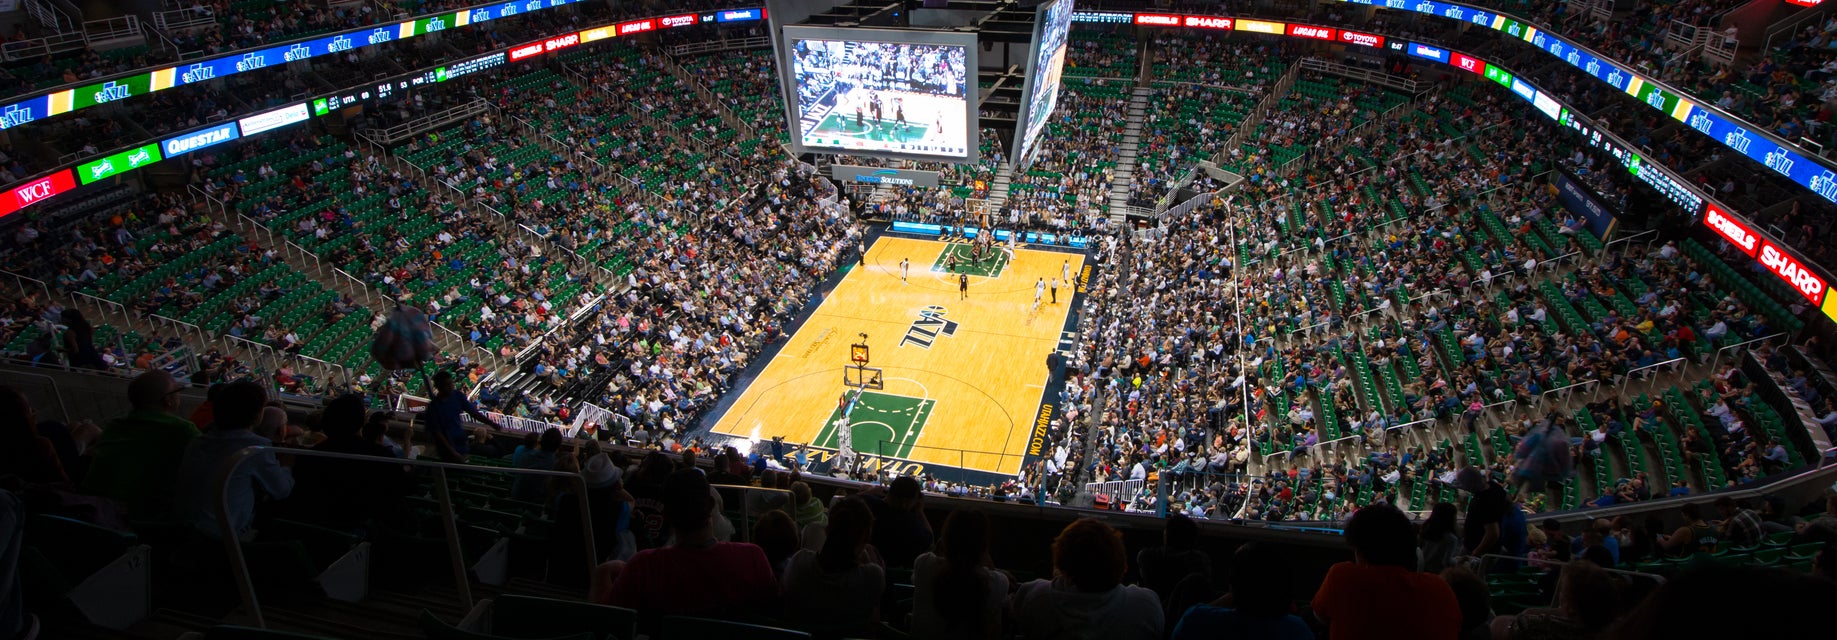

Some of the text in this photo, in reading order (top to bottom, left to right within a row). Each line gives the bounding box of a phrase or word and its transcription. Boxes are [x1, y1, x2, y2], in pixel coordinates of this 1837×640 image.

[1186, 16, 1230, 28] SHARP
[1293, 26, 1316, 36] LUCAS
[546, 34, 578, 50] SHARP
[1353, 34, 1378, 44] TOYOTA
[182, 62, 215, 83] JAZZ
[236, 52, 266, 72] JAZZ
[94, 81, 131, 103] JAZZ
[342, 95, 355, 104] UTA
[412, 76, 424, 86] POR
[168, 127, 231, 154] QUESTAR
[1725, 127, 1751, 154] JAZZ
[1765, 147, 1794, 176] JAZZ
[18, 180, 51, 203] WCF
[1708, 210, 1756, 250] SCHEELS
[1760, 245, 1822, 299] SHARP
[898, 305, 959, 351] JAZZ
